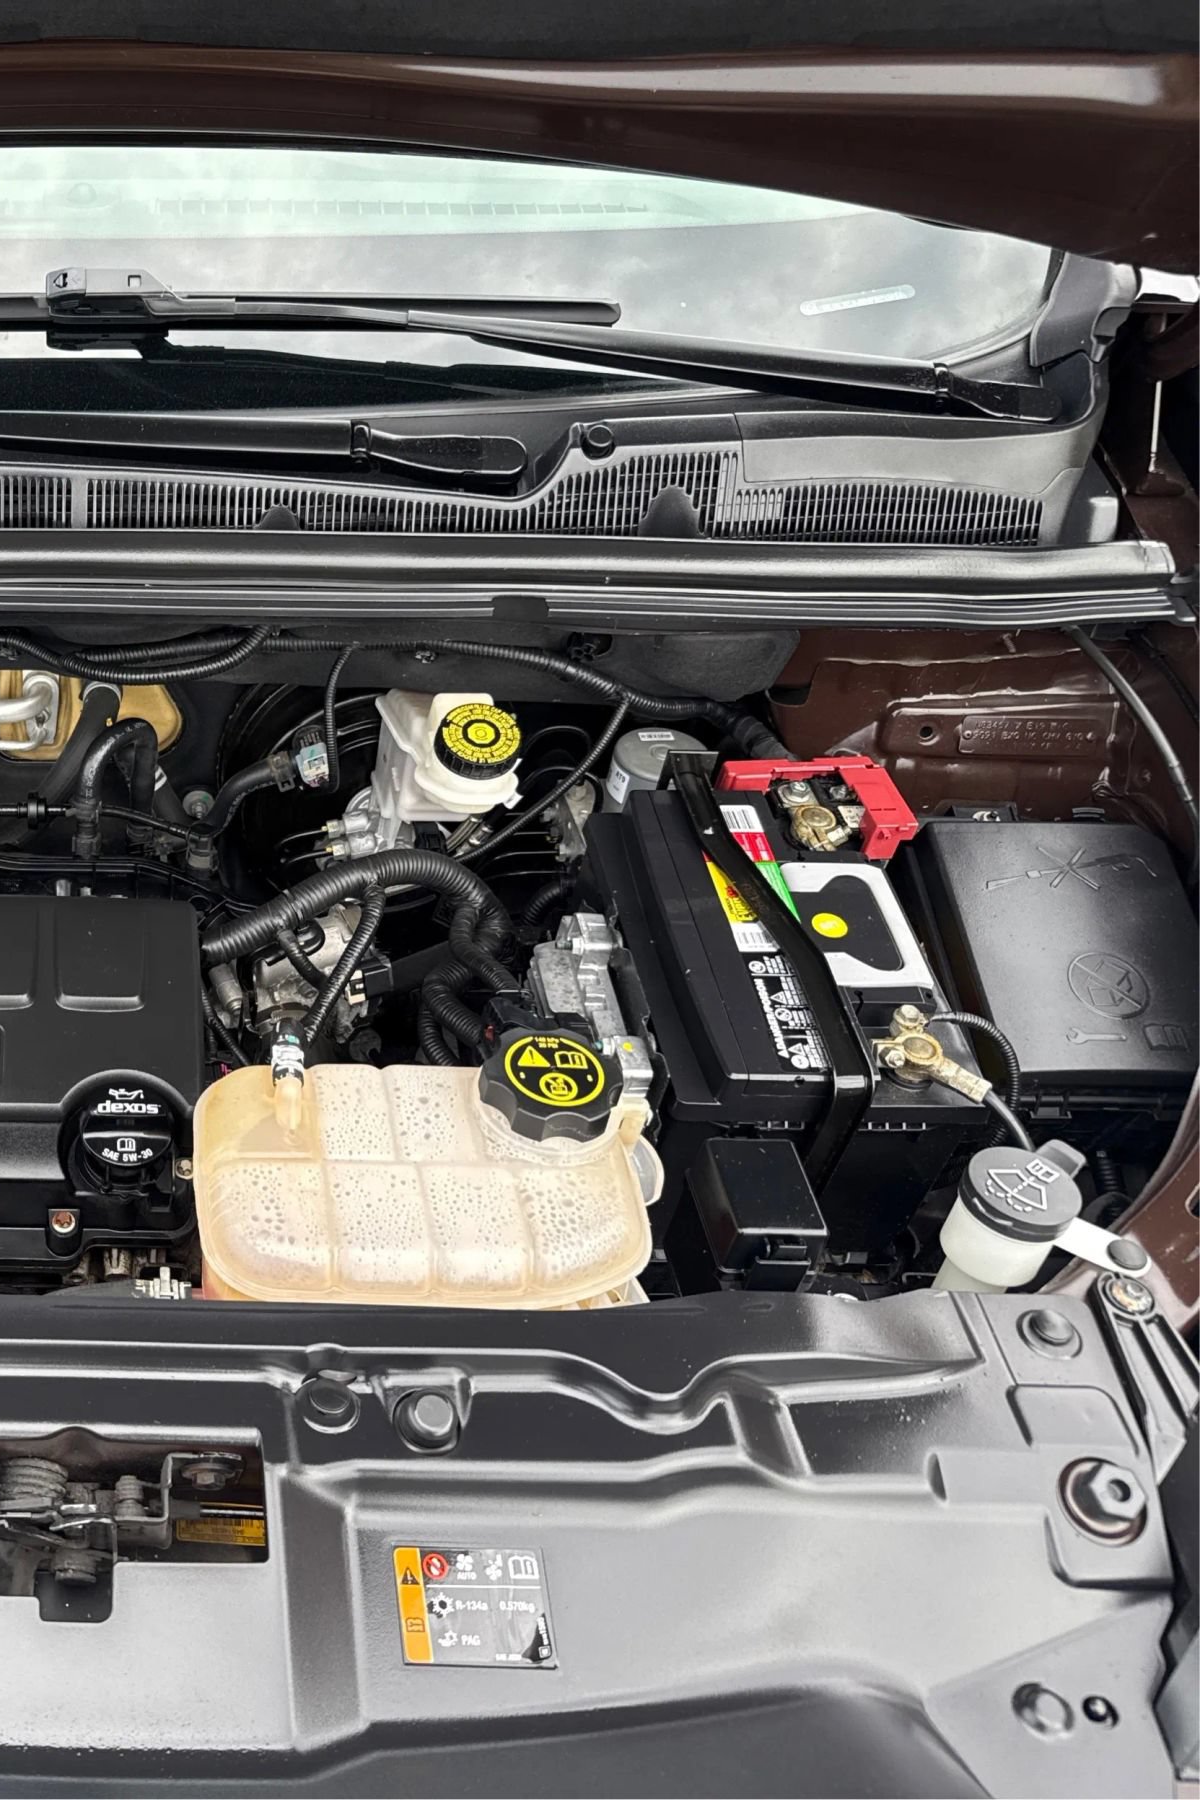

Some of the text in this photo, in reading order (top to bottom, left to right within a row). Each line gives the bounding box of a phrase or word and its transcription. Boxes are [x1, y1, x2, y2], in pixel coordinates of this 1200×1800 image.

[97, 1100, 159, 1114] dexos
[102, 1148, 153, 1162] SAE 5W-30
[457, 1572, 477, 1580] AUTO
[456, 1601, 536, 1613] R-134a 0.570kg
[461, 1635, 481, 1646] PAG
